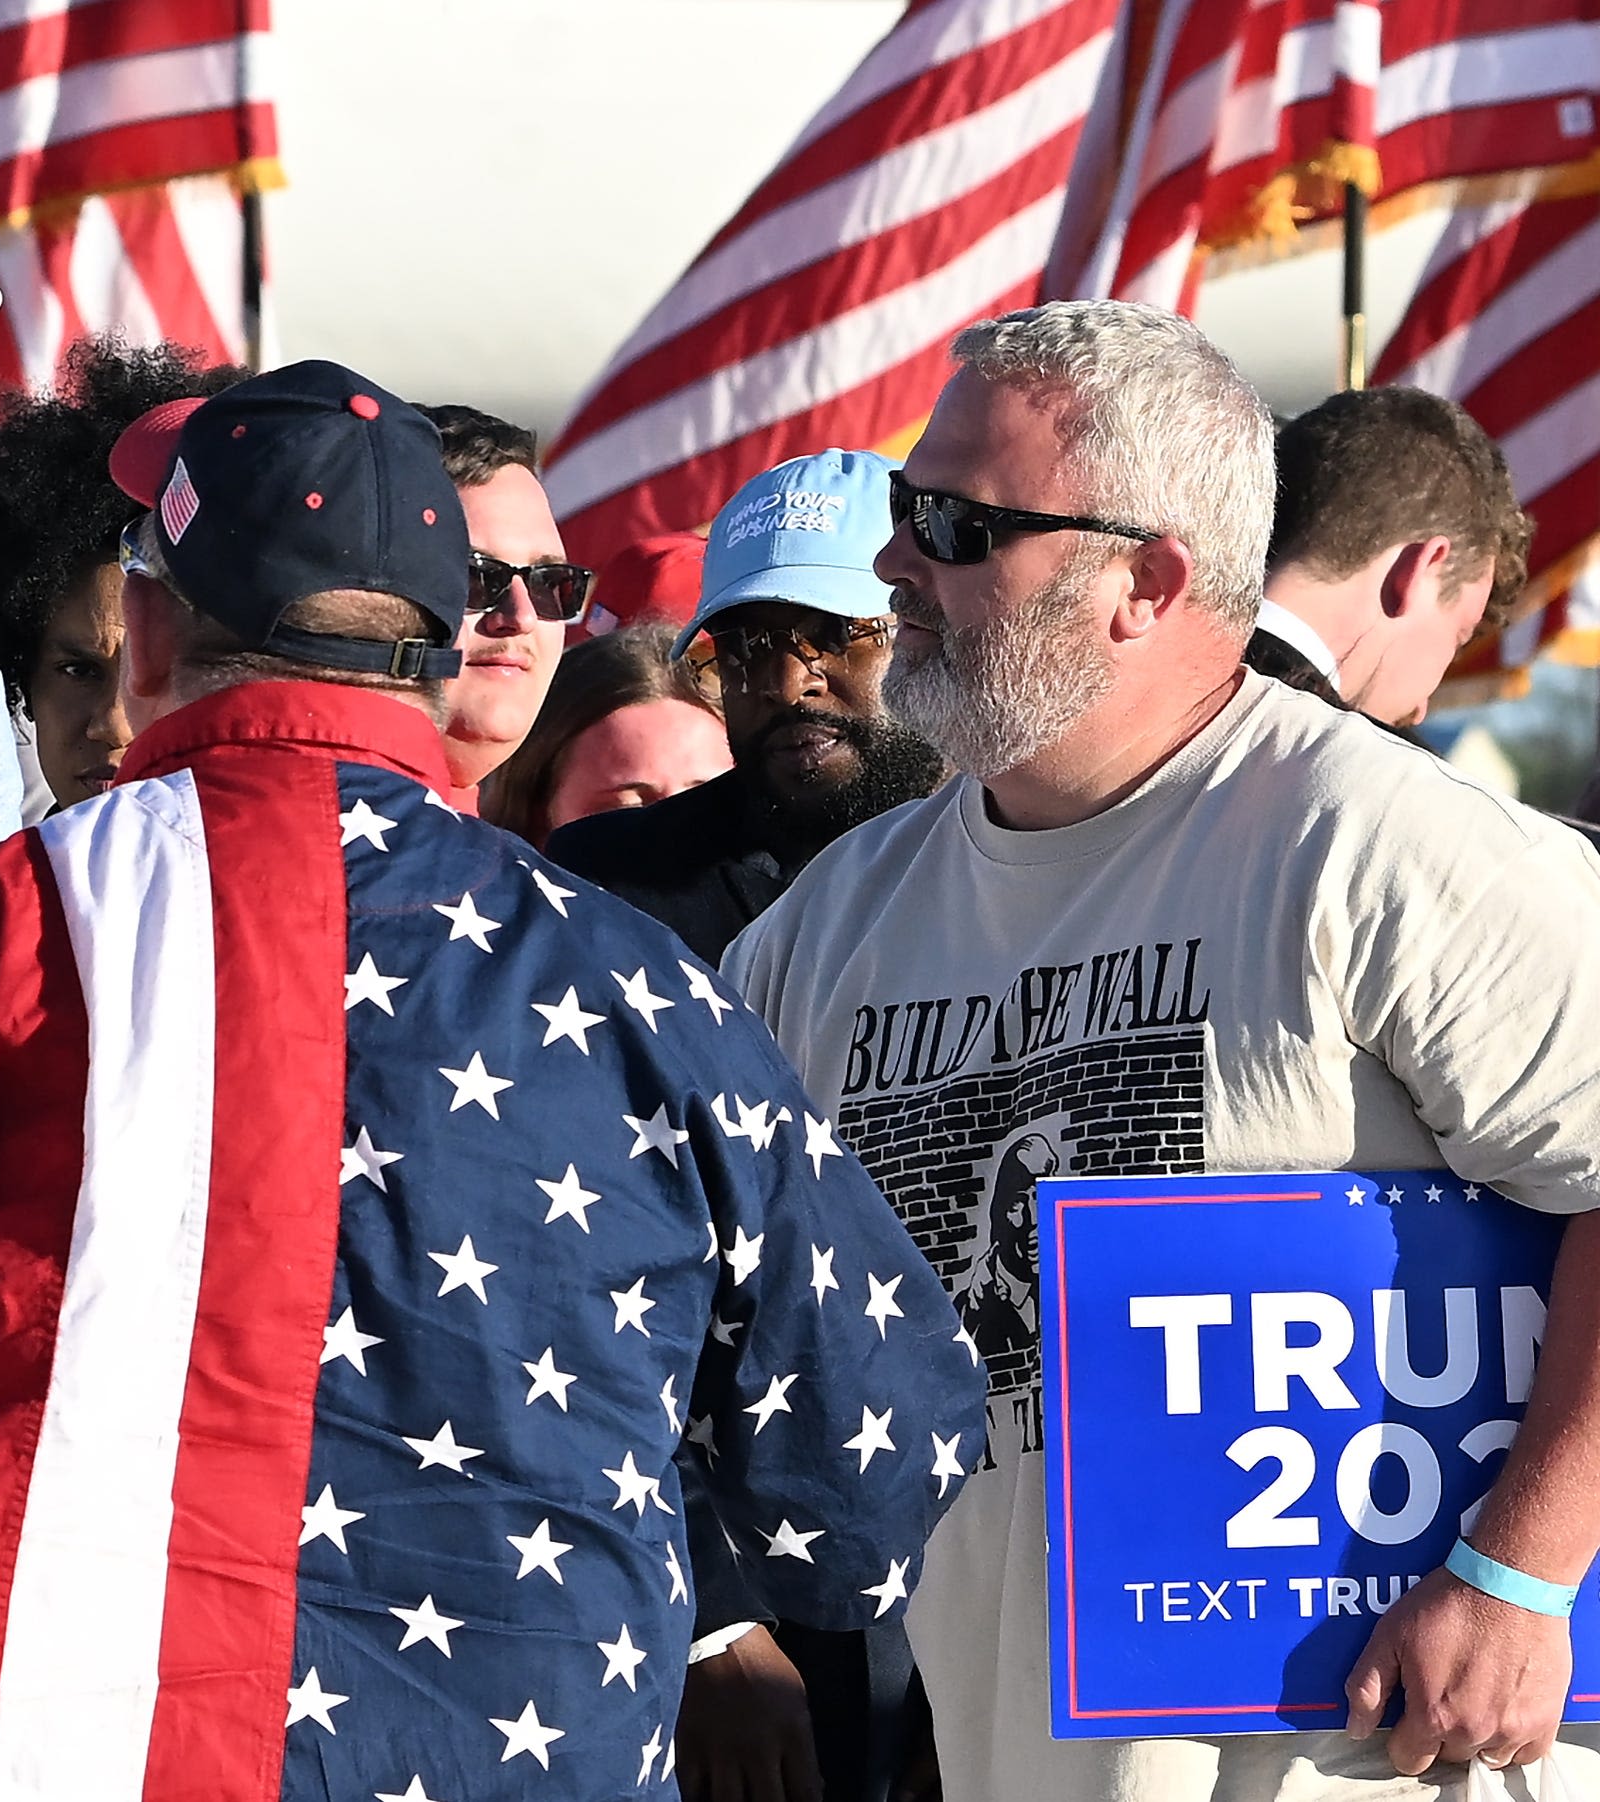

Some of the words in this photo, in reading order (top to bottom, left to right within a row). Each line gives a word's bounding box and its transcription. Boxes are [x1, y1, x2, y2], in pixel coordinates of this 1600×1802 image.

[727, 493, 782, 533] MIND
[784, 490, 846, 512] YOUR
[841, 994, 992, 1096] BUILD
[991, 962, 1084, 1064] THE
[1083, 937, 1211, 1038] WALL
[1123, 1578, 1268, 1623] TEXT
[1288, 1575, 1422, 1618] TRU
